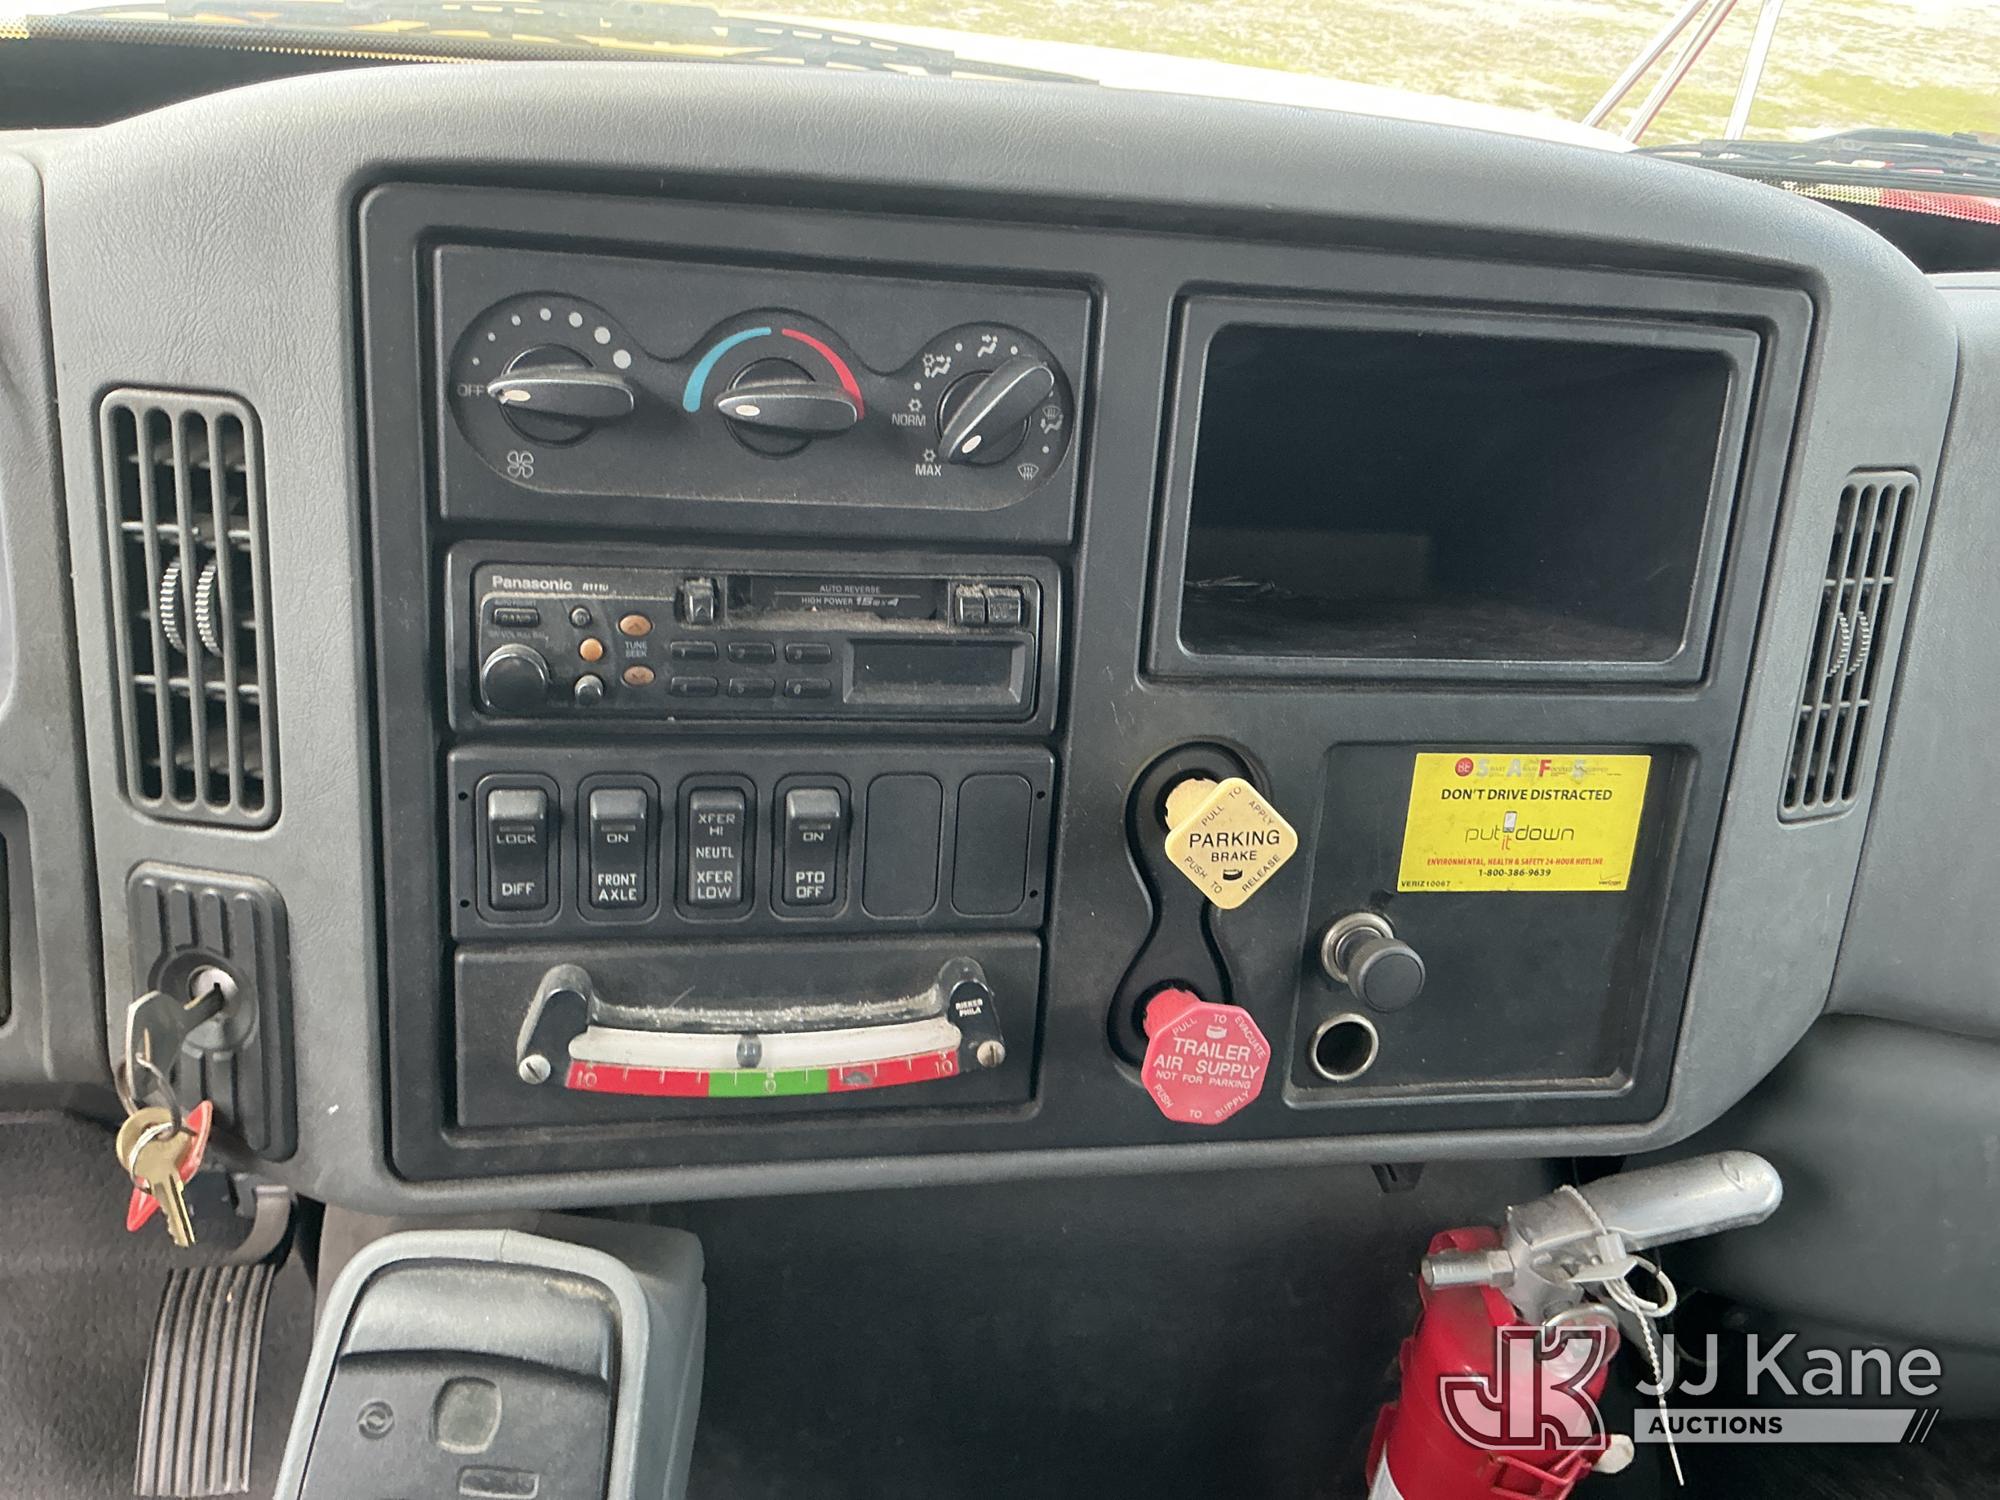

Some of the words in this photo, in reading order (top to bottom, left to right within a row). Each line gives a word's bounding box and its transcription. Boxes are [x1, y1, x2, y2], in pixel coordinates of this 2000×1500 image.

[892, 413, 926, 427] NORM
[915, 464, 942, 476] MAX
[492, 575, 573, 591] Panasonic
[820, 585, 842, 593] AUTO
[844, 585, 880, 594] REVERSE
[801, 596, 822, 605] HIGH
[823, 597, 853, 606] POWER
[624, 641, 648, 650] TUNE
[625, 650, 648, 658] SEEK
[1441, 788, 1486, 801] DON'T
[1487, 788, 1528, 801] DRIVE
[1530, 788, 1613, 801] DISTRACTED
[1200, 806, 1225, 826] PULL
[1228, 787, 1242, 800] TO
[1248, 800, 1275, 826] APPLY
[698, 813, 736, 825] XFER
[709, 826, 724, 836] HI
[803, 832, 824, 842] ON
[1465, 825, 1502, 843] put
[1501, 834, 1512, 850] it
[1515, 825, 1575, 841] down
[496, 834, 536, 844] LOCK
[607, 833, 629, 844] ON
[1189, 829, 1281, 848] PARKING
[696, 846, 735, 859] NEUTL
[1211, 850, 1258, 863] BRAKE
[1488, 857, 1513, 865] HEALTH
[1520, 857, 1544, 865] SAFETY
[696, 871, 733, 884] XFER
[796, 871, 825, 884] PTO
[1184, 855, 1209, 879] PUSH
[1210, 881, 1223, 894] TO
[1241, 854, 1281, 893] RELEASE
[1479, 868, 1552, 877] 1-800-386-9639
[598, 873, 637, 887] FRONT
[502, 882, 536, 897] DIFF
[599, 887, 637, 901] AXLE
[697, 886, 732, 899] LOW
[796, 886, 824, 899] OFF
[1172, 1016, 1197, 1036] PULL
[1213, 1014, 1227, 1024] TO
[1234, 1015, 1267, 1060] EVACUATE
[1173, 1037, 1251, 1062] TRAILER
[1153, 1054, 1183, 1071] AIR
[1195, 1060, 1260, 1080] SUPPLY
[576, 1070, 597, 1087] 10
[764, 1079, 777, 1094] 0
[935, 1060, 953, 1077] 10
[1156, 1071, 1178, 1081] NOT
[1182, 1074, 1203, 1084] FOR
[1209, 1078, 1251, 1089] PARKING
[1154, 1083, 1174, 1108] PUSH
[1190, 1109, 1202, 1119] TO
[1215, 1090, 1249, 1118] SUPPLY
